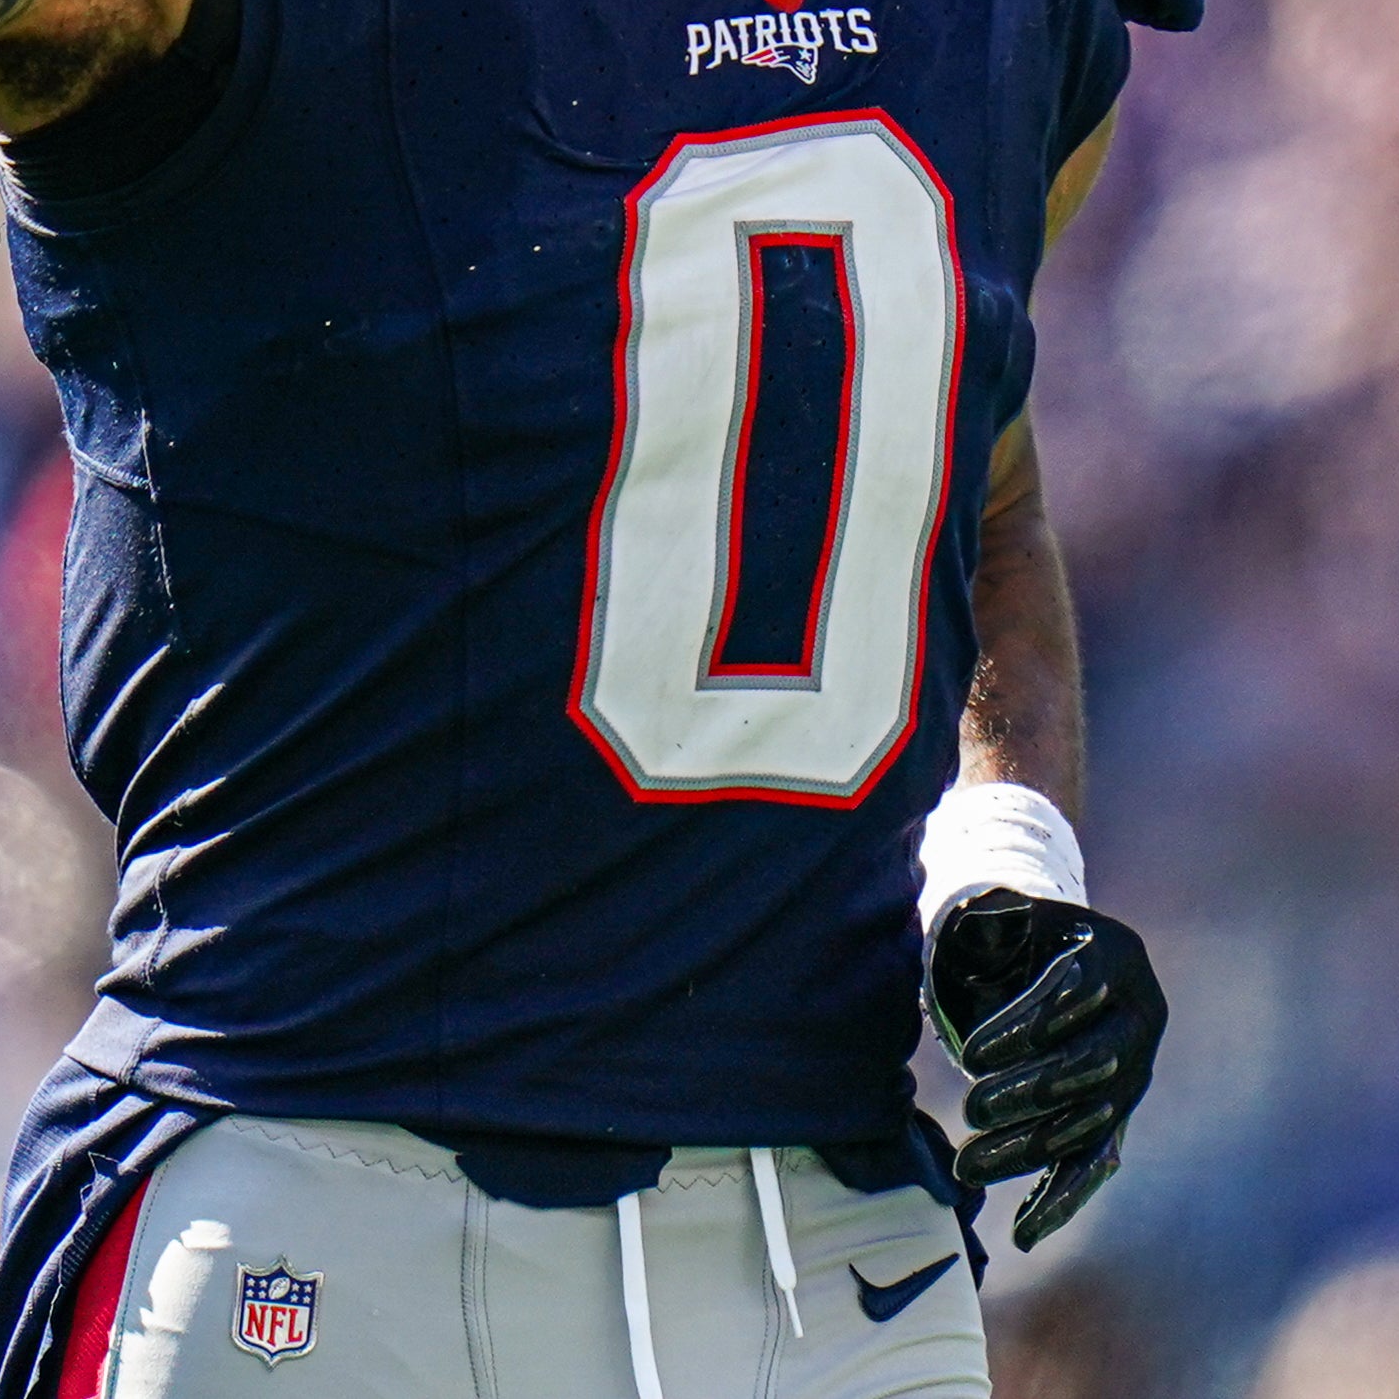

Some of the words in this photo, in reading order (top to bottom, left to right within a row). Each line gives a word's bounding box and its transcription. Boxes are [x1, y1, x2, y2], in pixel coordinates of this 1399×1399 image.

[686, 8, 877, 75] PATRIOTS
[566, 106, 965, 810] 0
[245, 1303, 303, 1347] NFL
